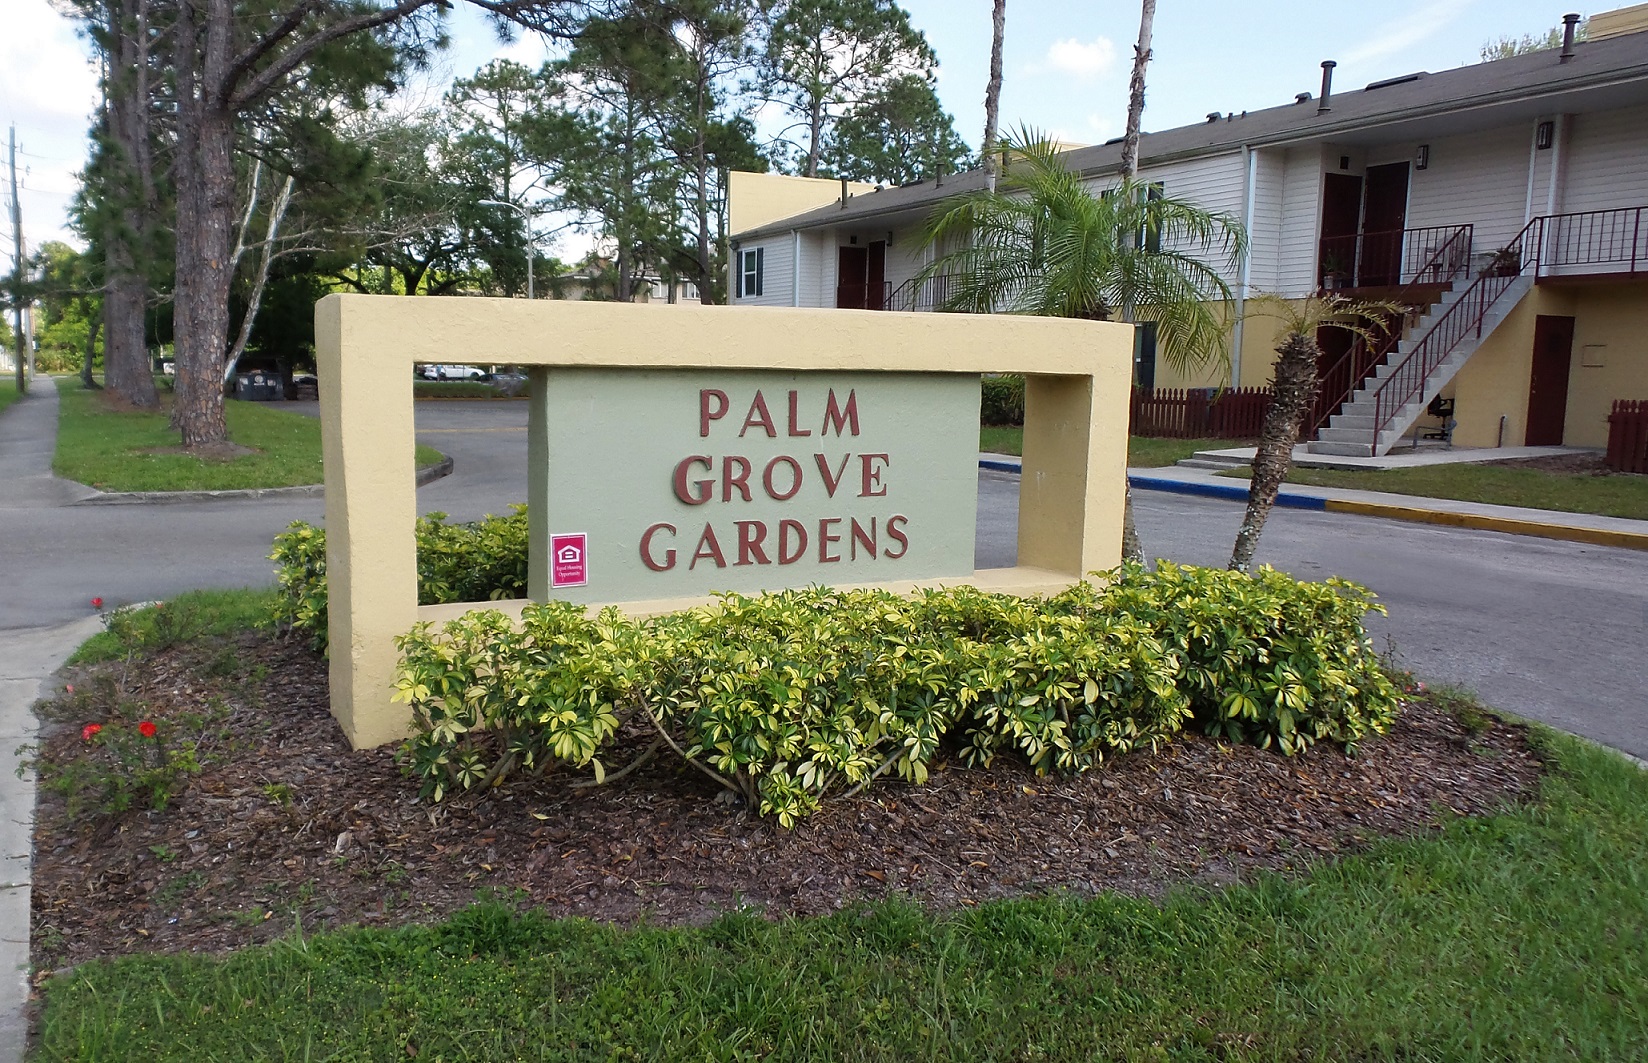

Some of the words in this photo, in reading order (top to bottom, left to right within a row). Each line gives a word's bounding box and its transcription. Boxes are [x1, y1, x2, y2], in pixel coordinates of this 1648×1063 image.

[700, 388, 860, 437] PALM
[673, 453, 890, 505] GROVE
[639, 515, 908, 571] GARDENS
